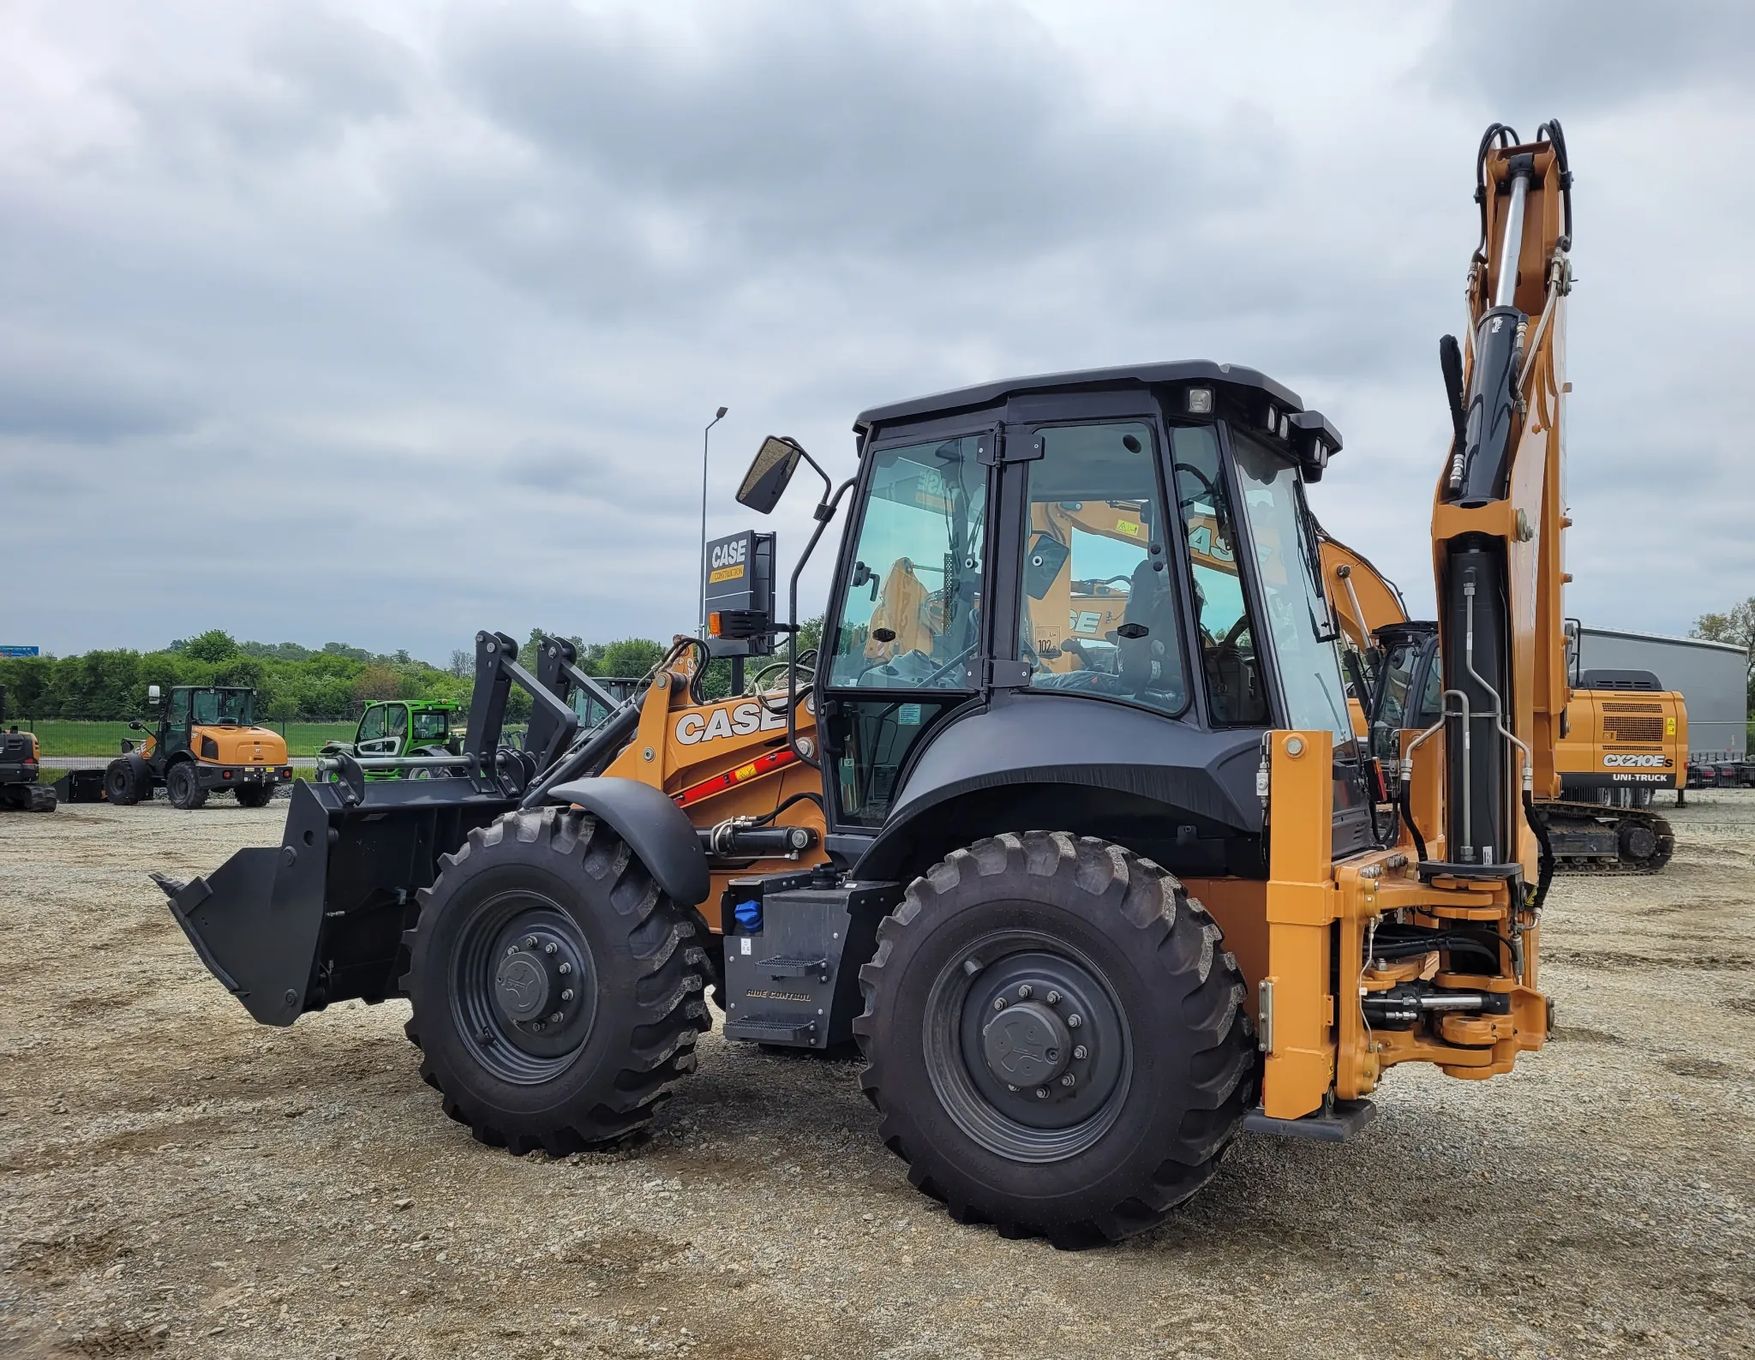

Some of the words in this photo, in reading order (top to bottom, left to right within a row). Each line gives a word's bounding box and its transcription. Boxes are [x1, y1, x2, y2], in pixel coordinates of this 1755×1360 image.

[712, 539, 747, 568] CASE
[1038, 640, 1052, 653] 102
[675, 699, 789, 745] CASE
[1613, 774, 1667, 782] UNI-TRUCK
[746, 989, 768, 998] RIDE
[769, 991, 811, 1001] CONTROL
